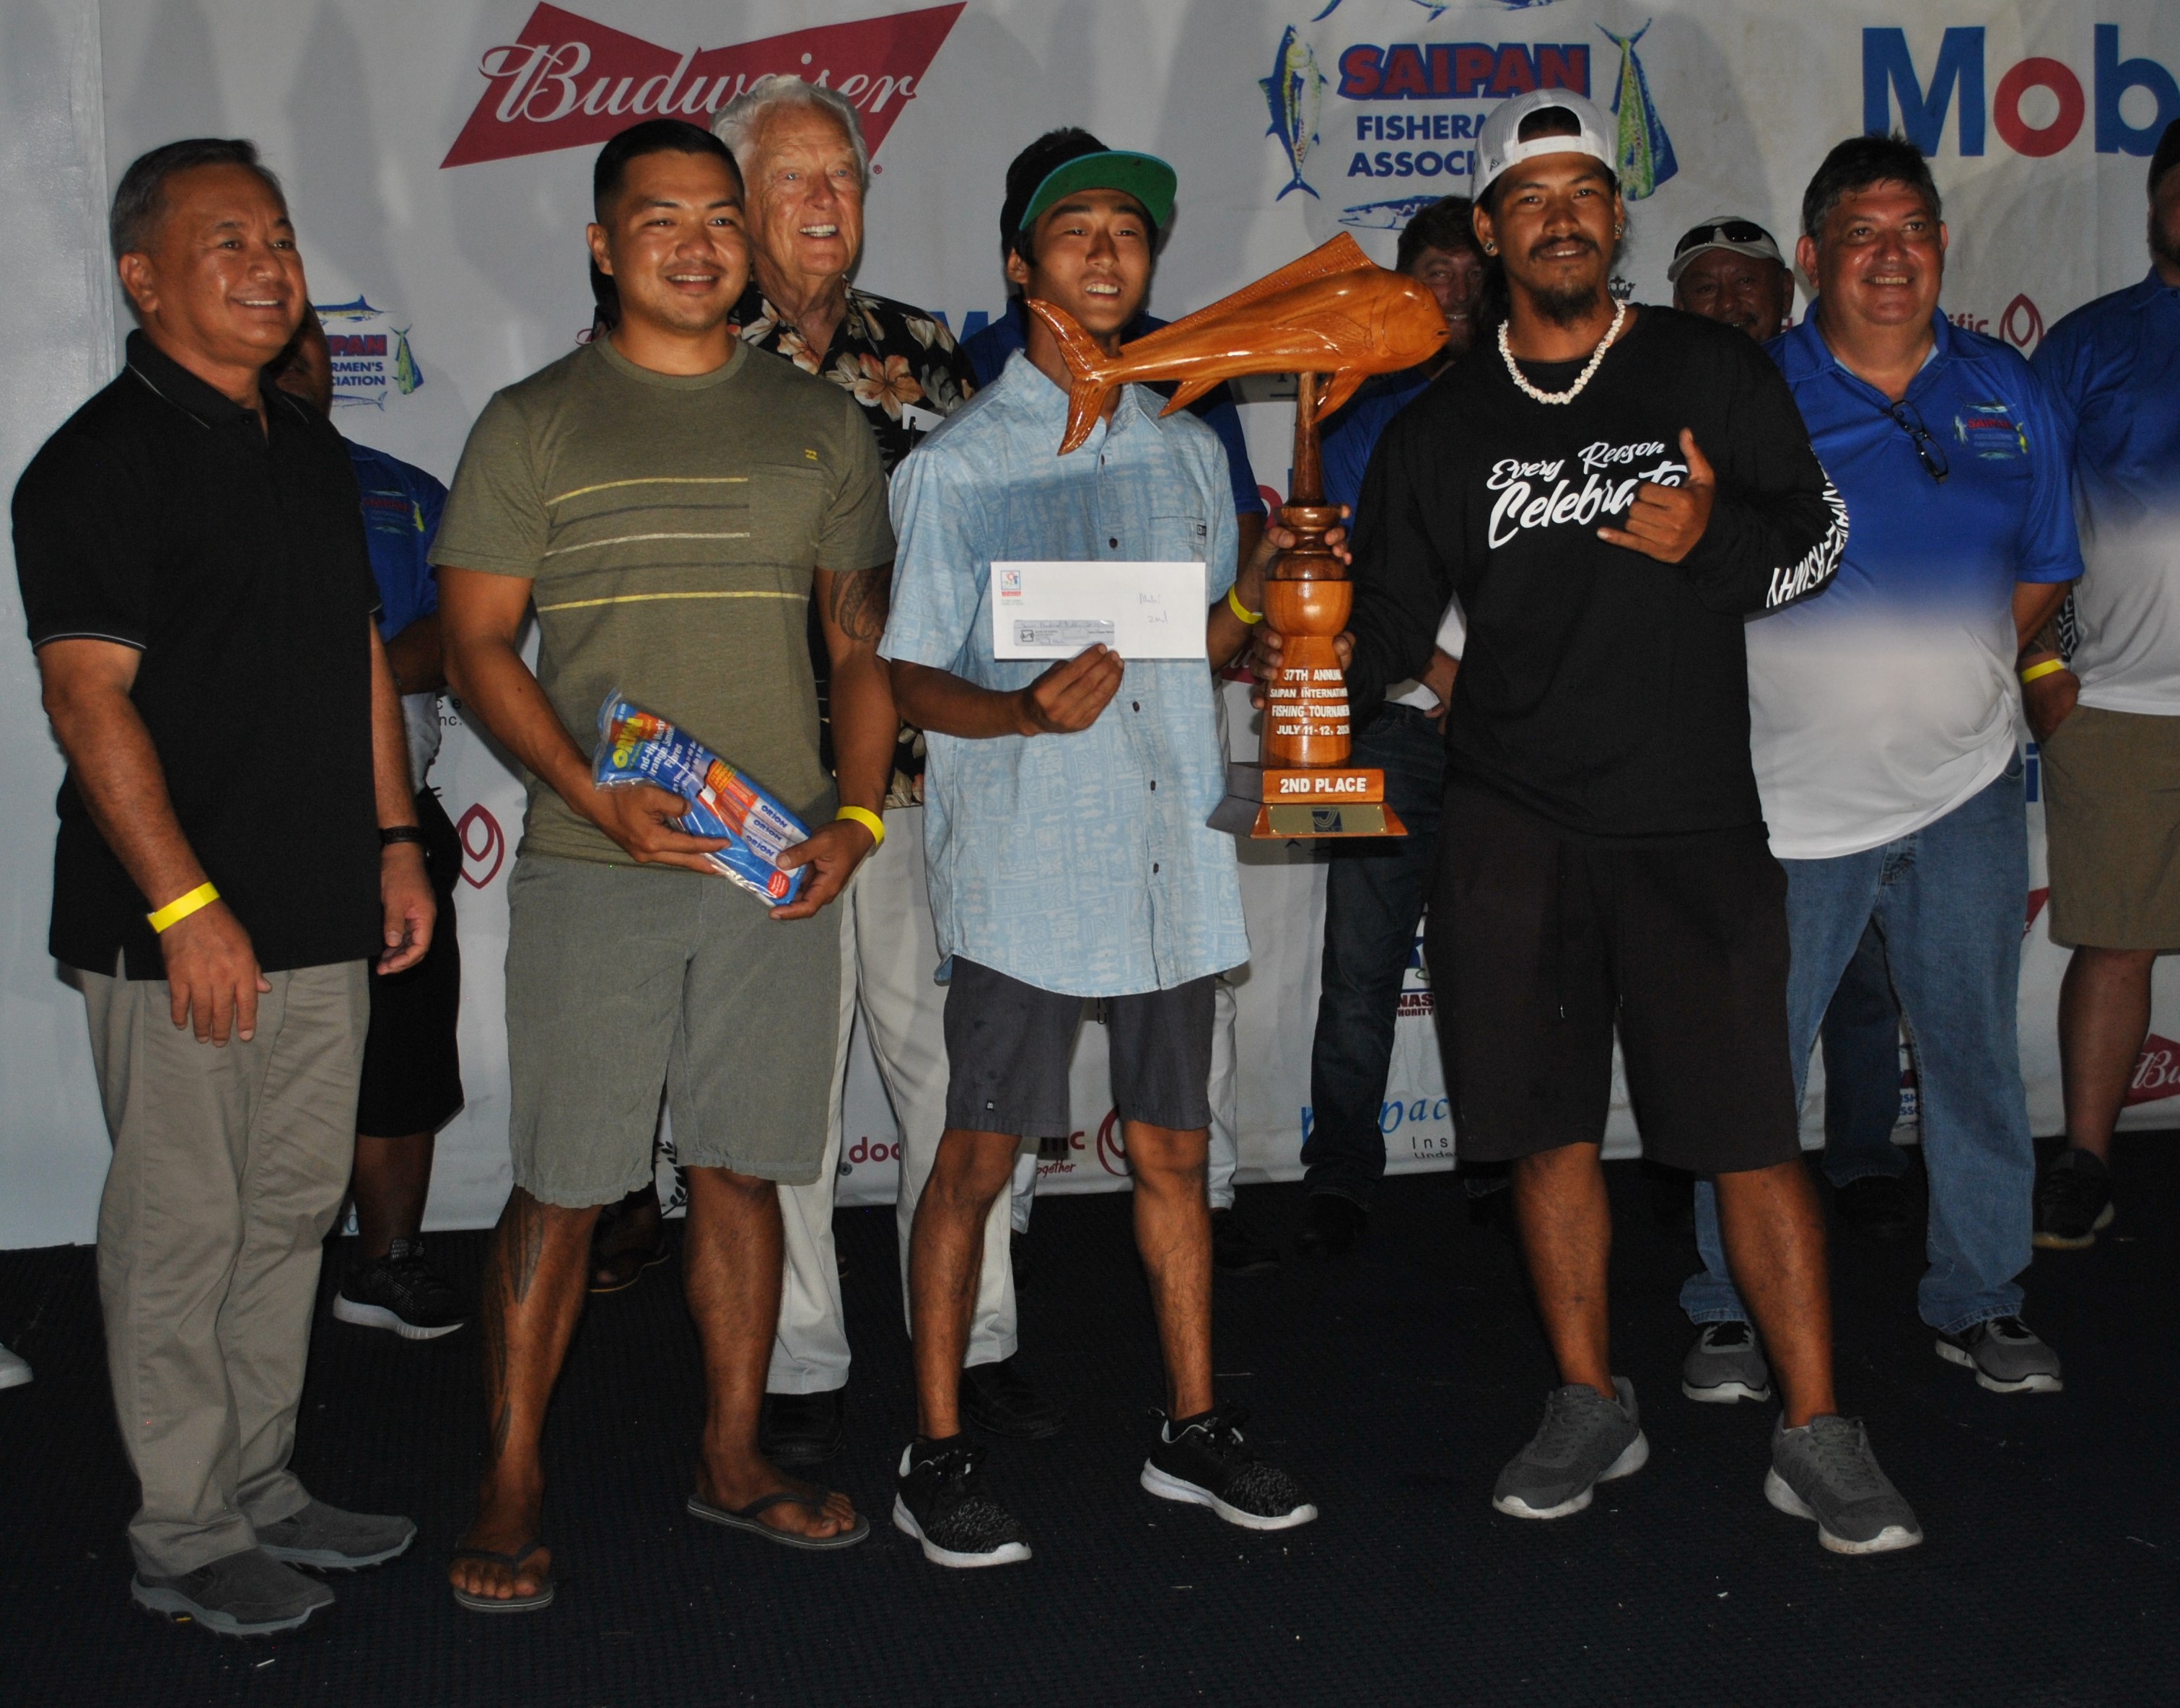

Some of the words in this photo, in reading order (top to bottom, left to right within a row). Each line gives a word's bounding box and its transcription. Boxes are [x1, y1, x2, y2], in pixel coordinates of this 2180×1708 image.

[478, 41, 917, 123] Budwser
[1337, 43, 1590, 100] SAIPAN
[1862, 24, 2179, 157] Mob
[1357, 114, 1486, 141] FISHER
[1347, 150, 1475, 177] ASSOCI
[327, 335, 387, 356] PAN
[331, 362, 383, 372] RMEN'S
[1487, 459, 1564, 490] Every
[1578, 441, 1665, 475] Reason
[1284, 669, 1308, 681] 37TH
[1270, 688, 1297, 698] SAIPAN
[1271, 705, 1305, 717] FISHING
[1277, 725, 1300, 735] JULY
[649, 746, 668, 776] range
[1280, 779, 1310, 793] 2ND
[1315, 777, 1367, 792] PLACE
[761, 804, 788, 828] ORION
[753, 819, 782, 841] ORION
[745, 834, 775, 857] ORION
[1397, 1007, 1433, 1017] HORITY
[1037, 1158, 1076, 1178] ogether
